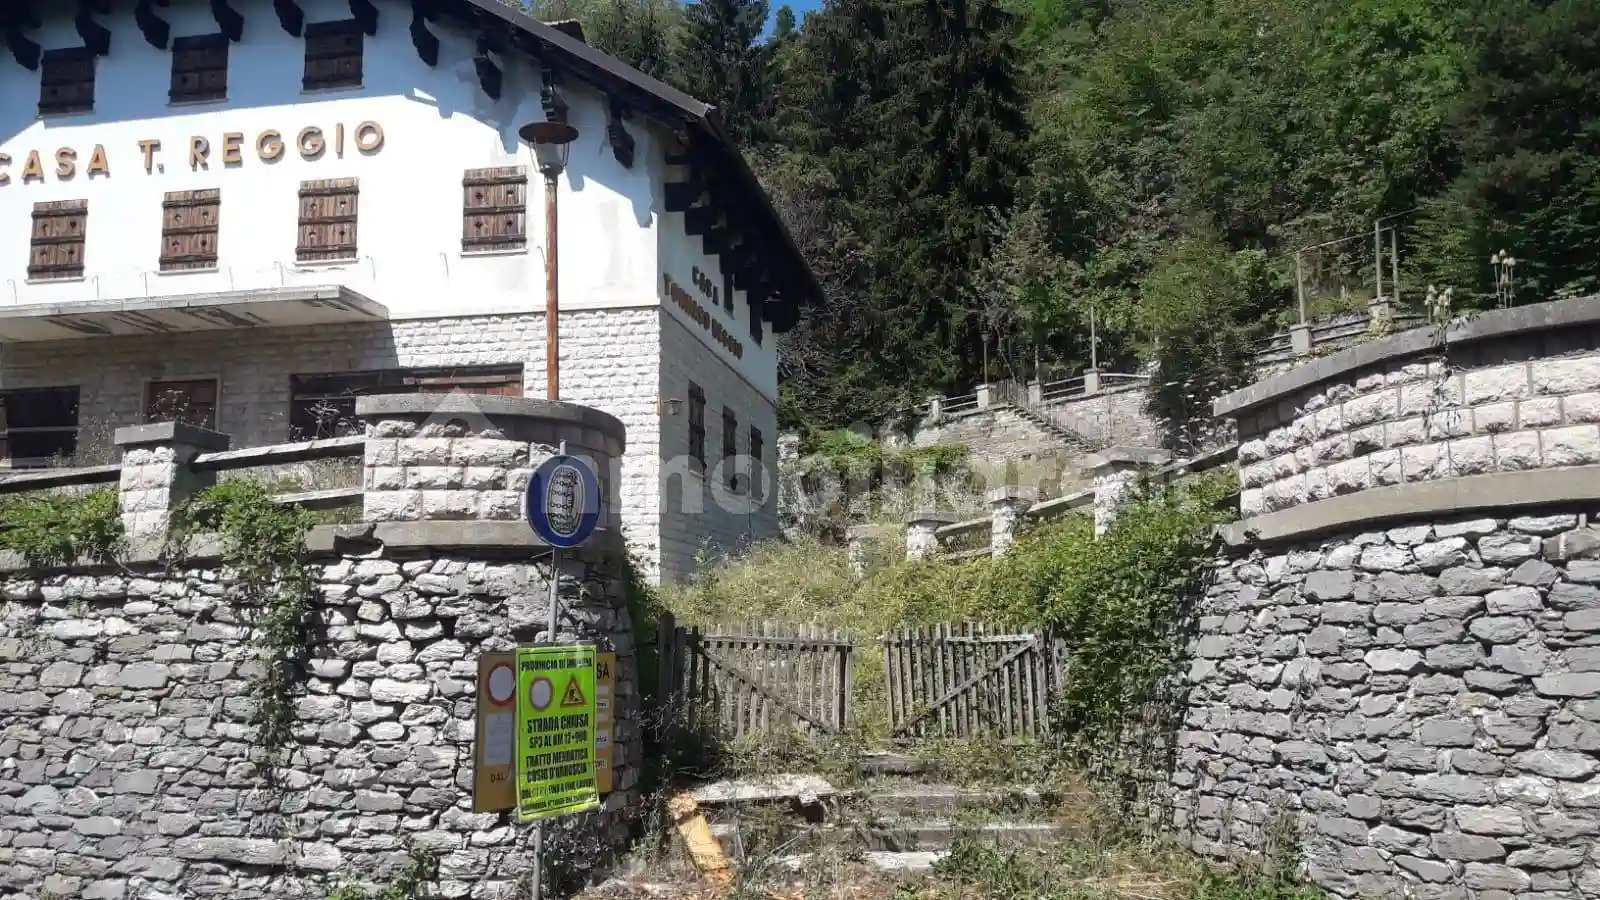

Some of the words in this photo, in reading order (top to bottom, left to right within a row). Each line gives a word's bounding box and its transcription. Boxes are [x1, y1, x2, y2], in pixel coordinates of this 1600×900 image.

[137, 138, 165, 176] T.
[189, 120, 386, 172] REGGIO
[691, 265, 719, 306] CASA
[527, 716, 560, 733] STRADA
[560, 713, 589, 730] CHIUSA
[526, 753, 552, 768] TRATTO
